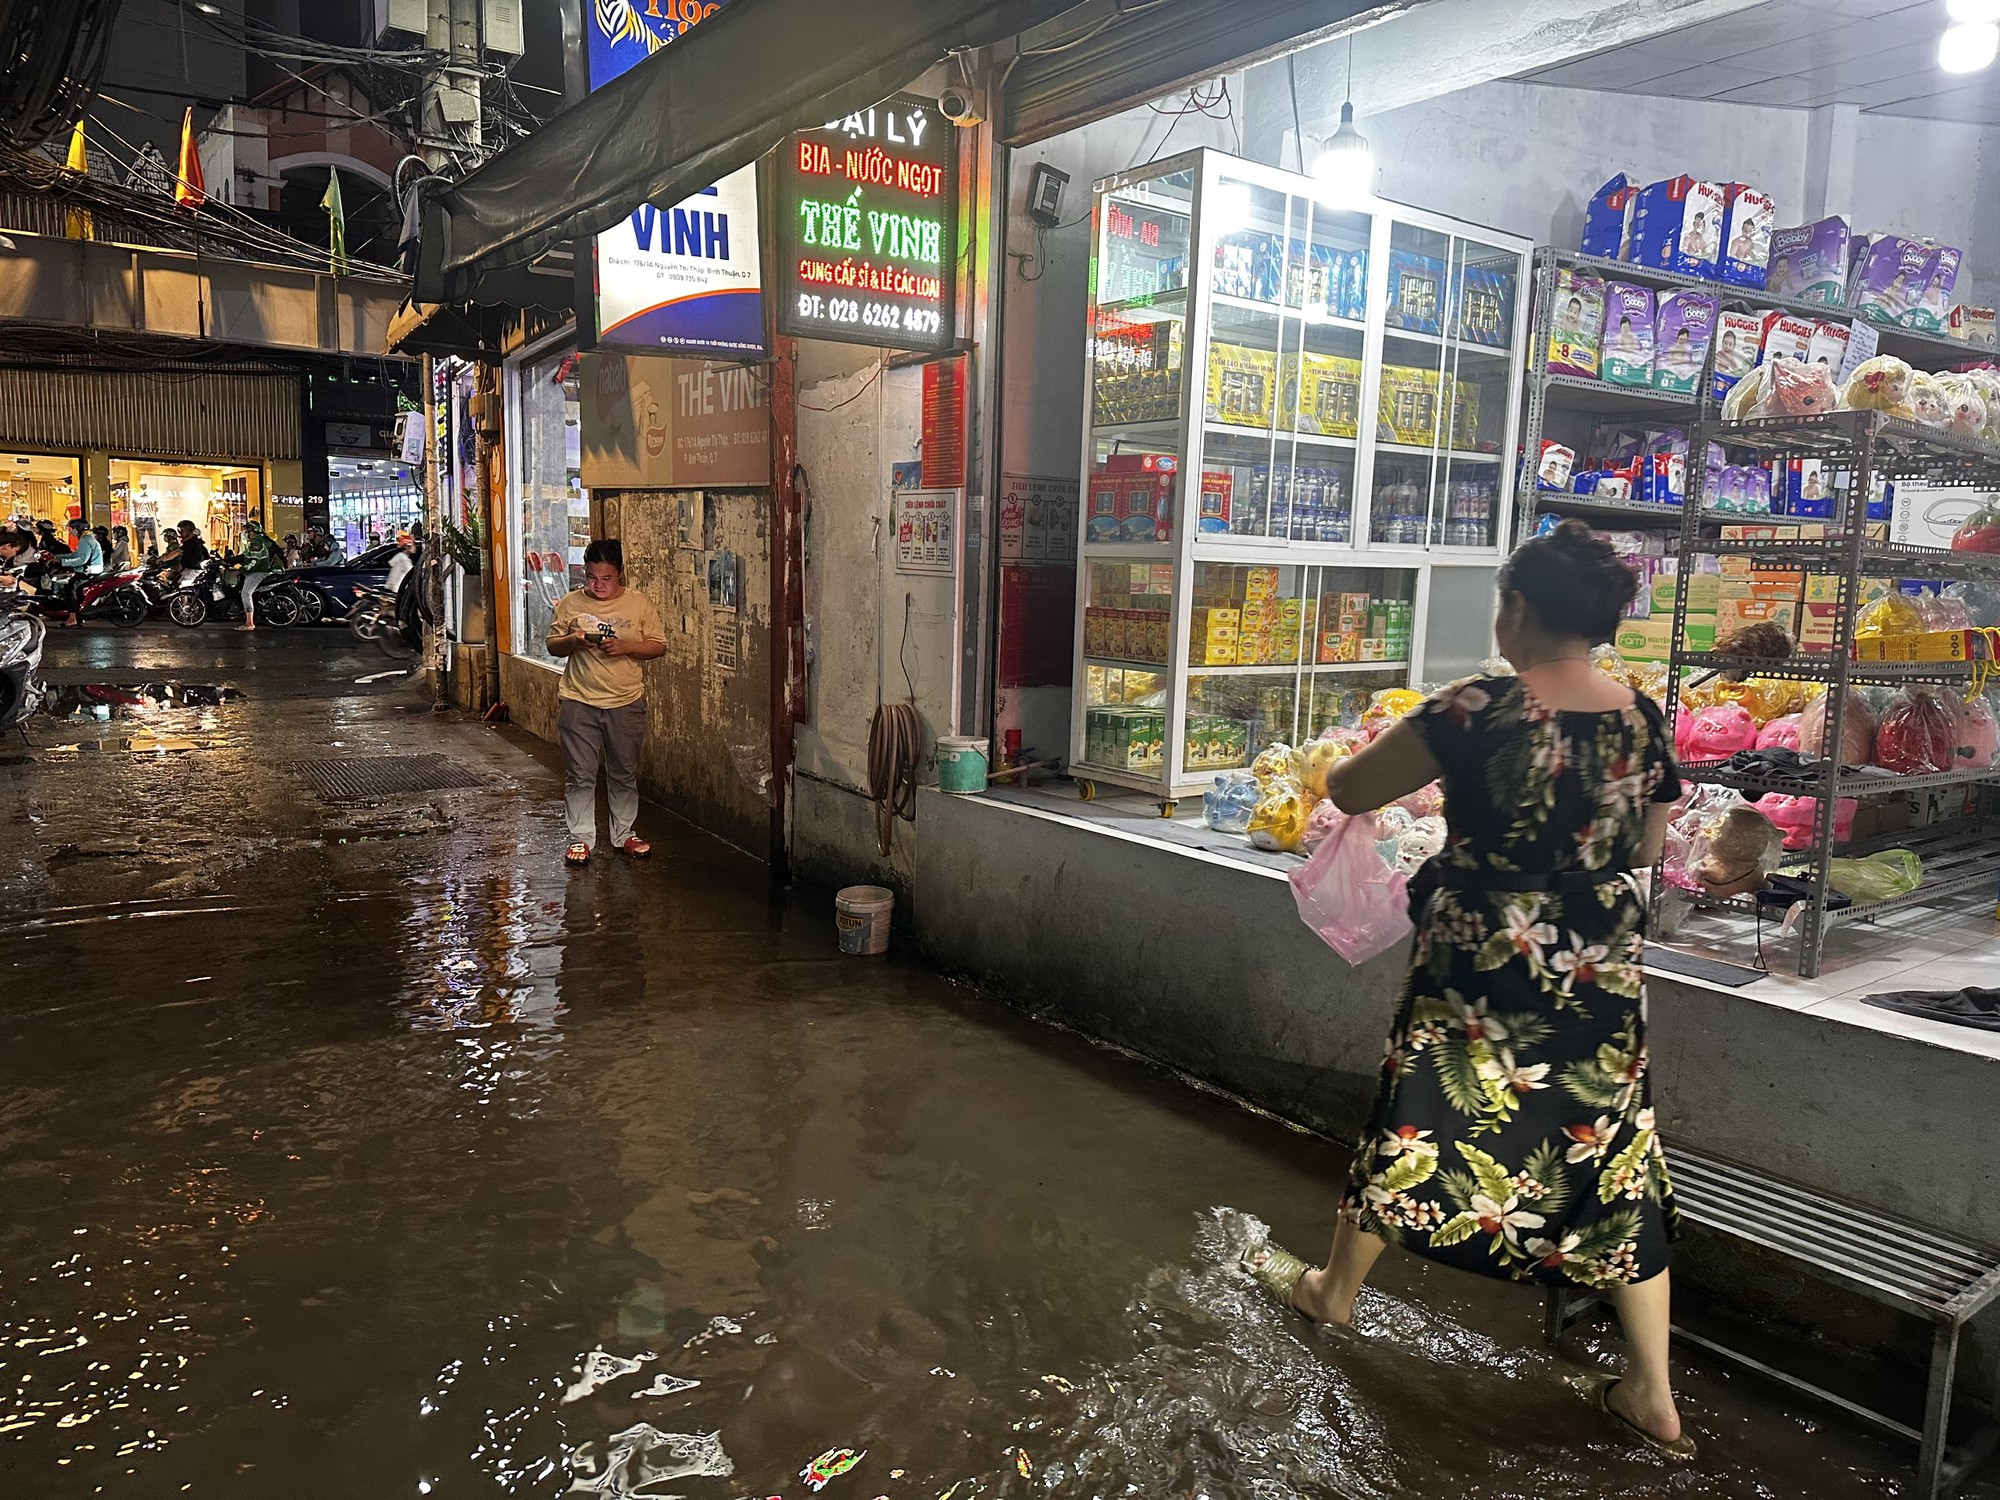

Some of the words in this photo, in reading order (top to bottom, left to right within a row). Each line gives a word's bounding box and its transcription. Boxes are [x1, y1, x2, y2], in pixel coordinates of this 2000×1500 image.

[887, 110, 928, 146] LÝ
[801, 143, 831, 174] BIA
[846, 147, 893, 185] NƯỚC
[897, 160, 942, 198] NGỌT
[631, 205, 729, 260] VINH
[801, 185, 863, 250] THẾ
[867, 210, 941, 263] VINH
[1777, 229, 1810, 248] Bobby
[1903, 249, 1926, 266] Bobby
[1941, 251, 1957, 267] Bobby
[801, 260, 834, 282] CUNG
[834, 257, 857, 286] CẤP
[870, 269, 879, 290] &
[894, 267, 916, 295] CÁC
[916, 277, 940, 302] LOẠI
[1624, 295, 1645, 309] Bobby
[798, 293, 825, 319] ĐT:
[829, 297, 859, 323] 028
[862, 302, 900, 329] 6262
[903, 307, 941, 334] 4879
[1686, 308, 1710, 321] Bobby
[1724, 317, 1759, 332] HUGGIES
[1780, 319, 1812, 339] HUGGIES
[1823, 325, 1850, 341] HUGG
[308, 496, 323, 504] 219
